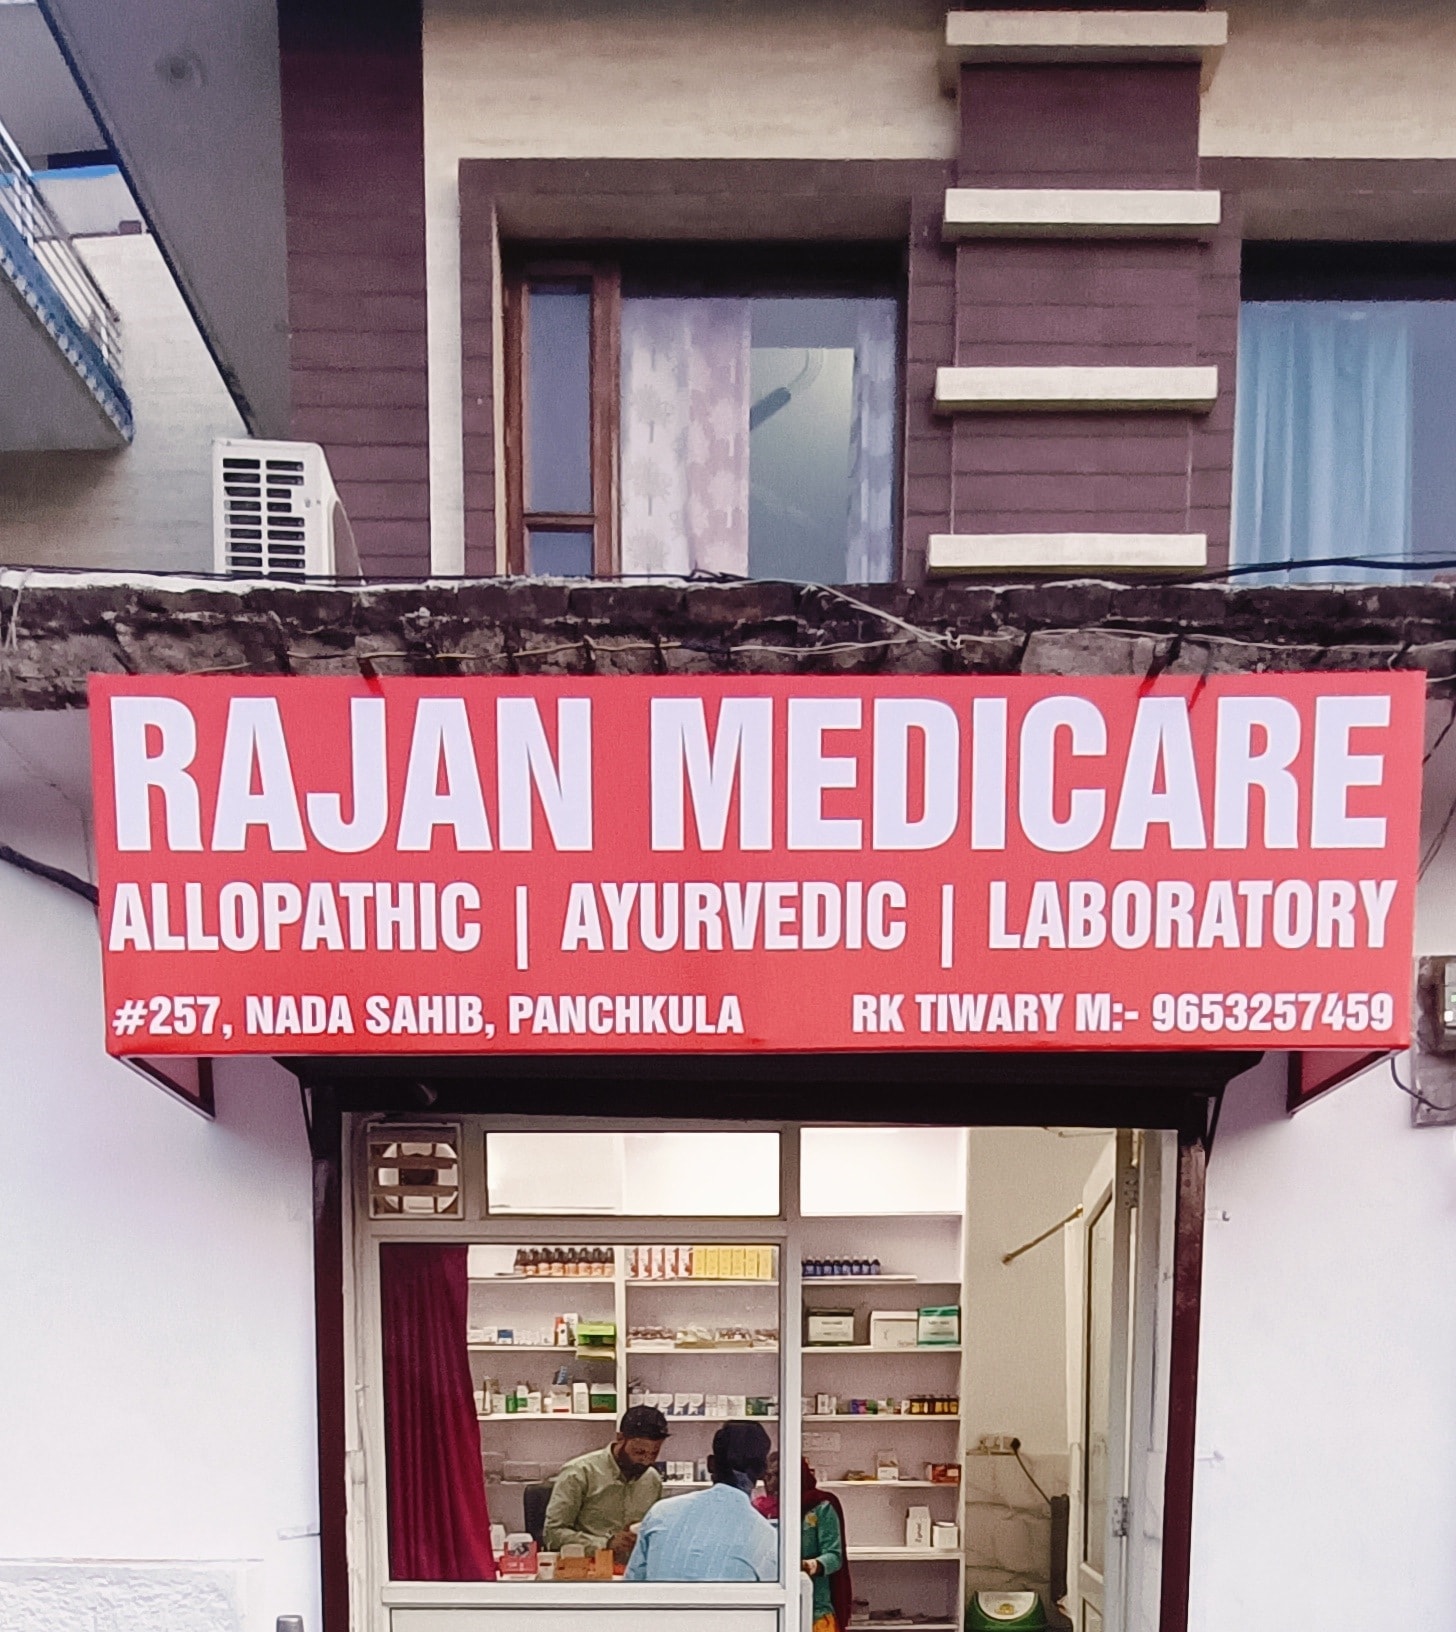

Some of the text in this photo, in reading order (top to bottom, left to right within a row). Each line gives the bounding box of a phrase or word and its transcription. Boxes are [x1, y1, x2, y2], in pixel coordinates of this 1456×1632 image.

[109, 695, 1392, 853] RAJAN MEDICARE
[109, 881, 482, 952] ALLOPATHIC
[561, 880, 908, 952] AYURVEDIC
[988, 879, 1398, 950] LABORATORY
[112, 995, 745, 1040] #257, NADA SAHIB, PANCHKULA
[852, 992, 1394, 1034] RK TIWARY M:- 9653257459
